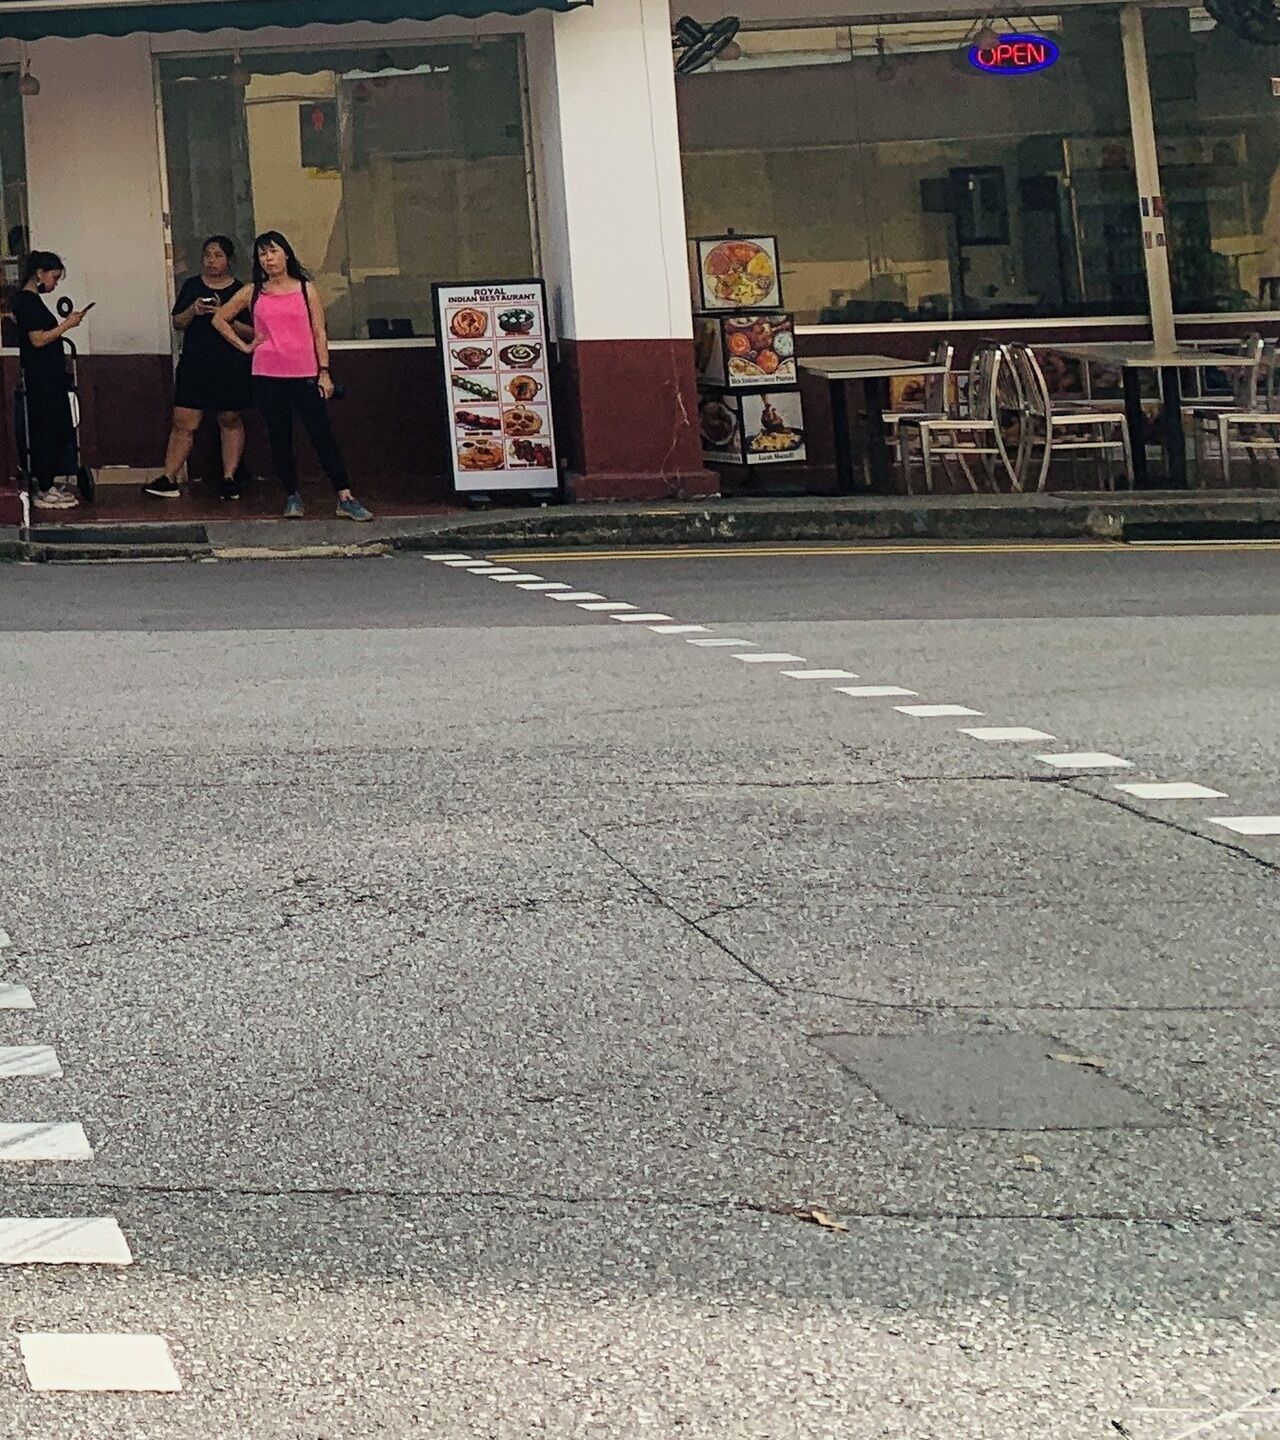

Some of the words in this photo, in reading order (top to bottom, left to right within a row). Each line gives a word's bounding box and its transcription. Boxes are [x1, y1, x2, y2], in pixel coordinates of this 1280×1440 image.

[978, 43, 1045, 67] OPEN
[473, 287, 507, 297] ROYAL
[448, 295, 478, 303] INDIAN
[479, 293, 536, 302] RESTAURANT
